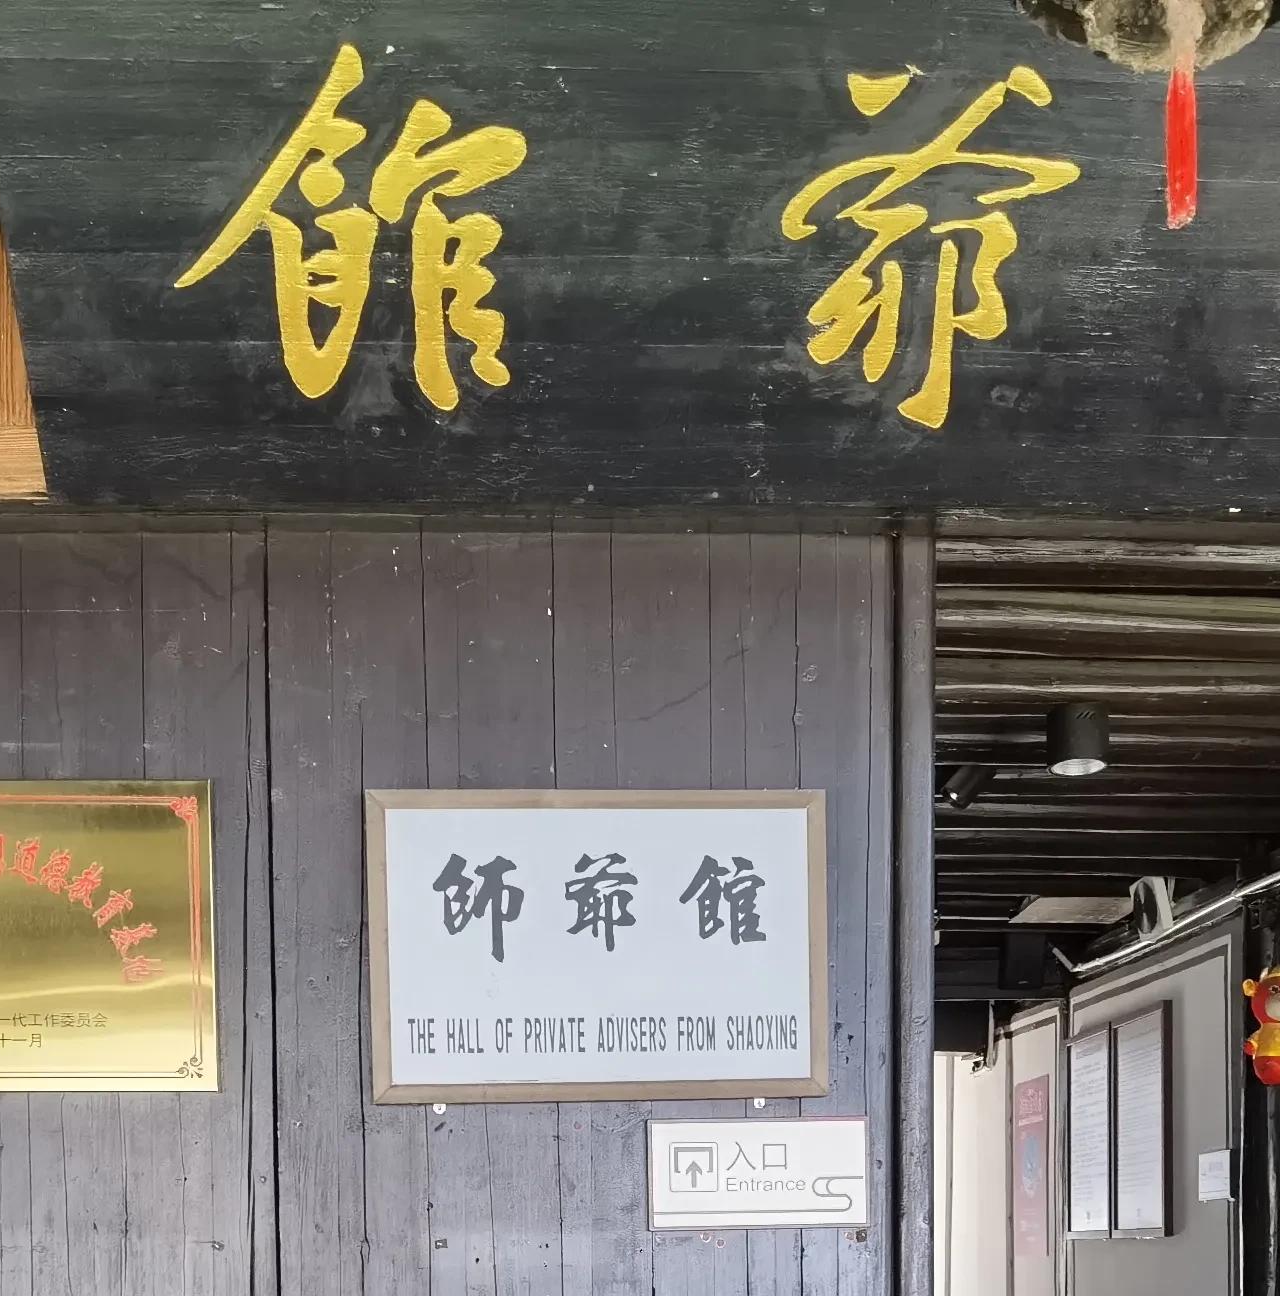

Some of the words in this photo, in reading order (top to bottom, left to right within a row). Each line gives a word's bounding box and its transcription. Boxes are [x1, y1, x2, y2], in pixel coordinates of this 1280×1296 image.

[408, 1018, 436, 1054] THE
[447, 1018, 484, 1053] HALL
[495, 1018, 513, 1053] OF
[524, 1017, 586, 1053] PRIVATE
[597, 1017, 667, 1052] ADVISERS
[677, 1016, 716, 1052] FROM
[726, 1014, 798, 1051] SHAOXING
[726, 1141, 788, 1170] 入口
[726, 1176, 806, 1193] Entrance
